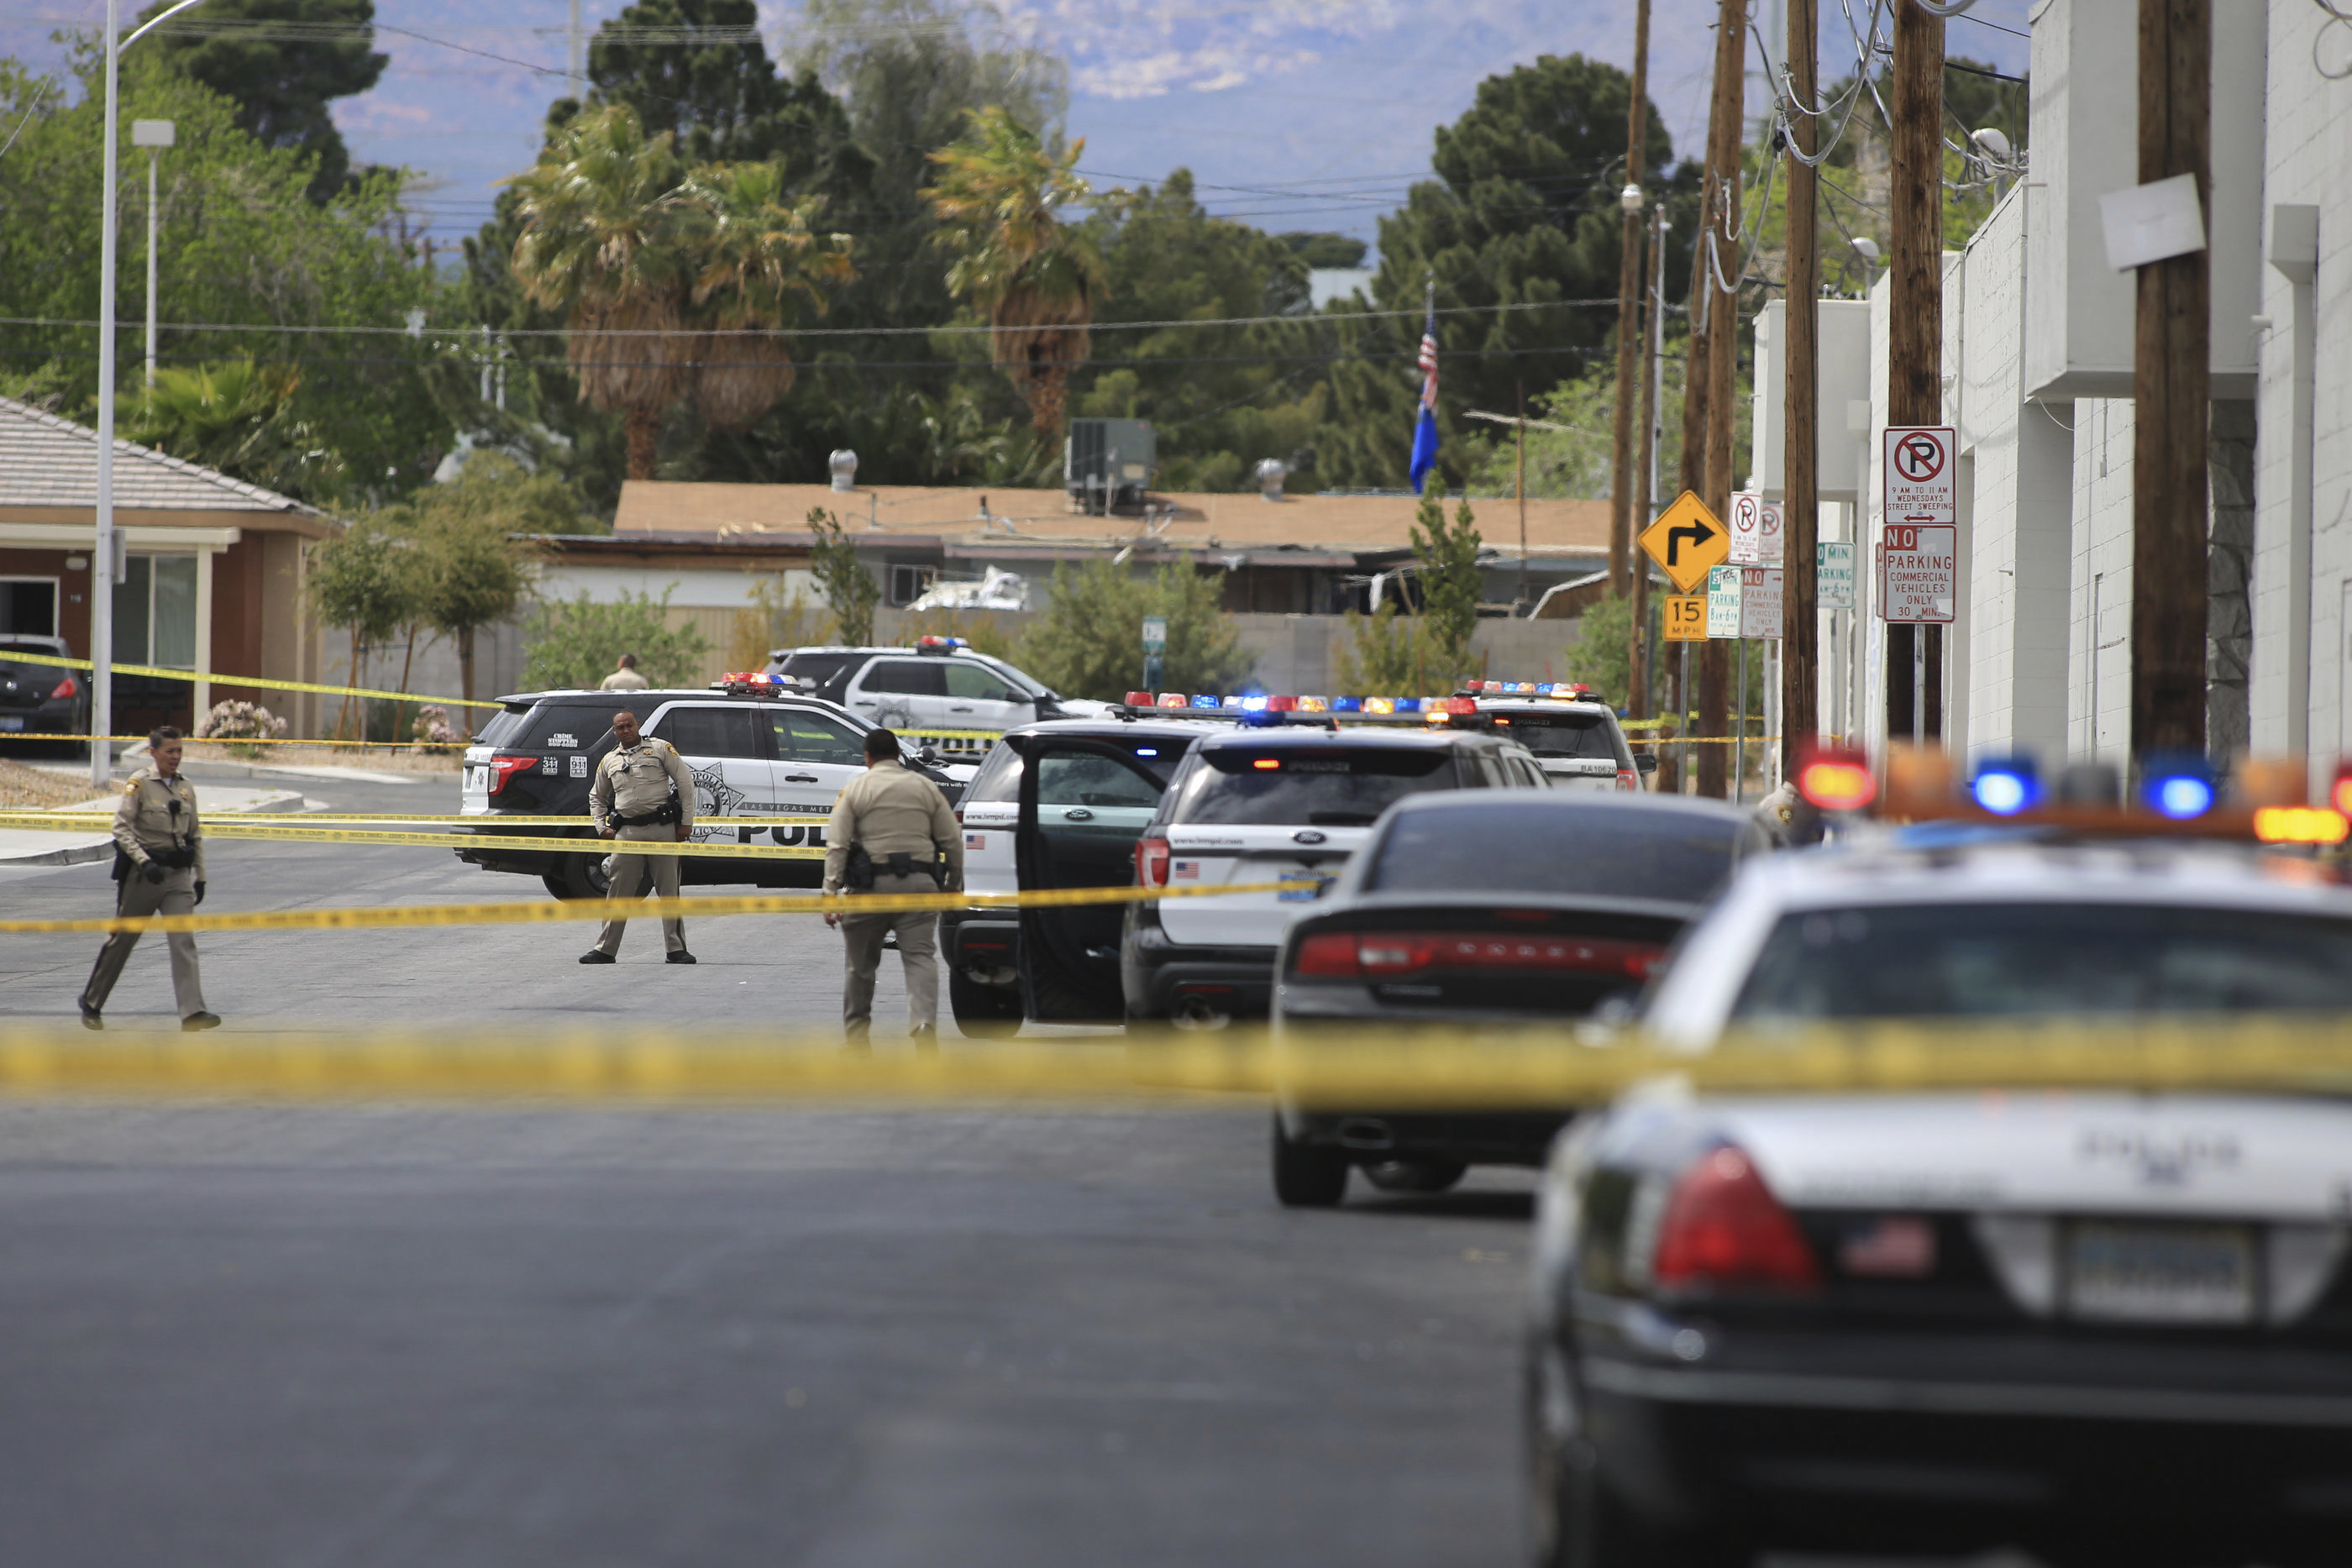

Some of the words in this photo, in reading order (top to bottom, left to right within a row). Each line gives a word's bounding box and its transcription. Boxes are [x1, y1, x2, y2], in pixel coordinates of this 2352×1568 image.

[1887, 528, 1914, 547] NO
[1888, 555, 1952, 569] PARKING
[1744, 570, 1762, 584] NO
[1890, 573, 1949, 581] COMMERCIAL
[1895, 584, 1945, 593] VEHICLES
[1710, 593, 1740, 606] PARKING
[1907, 595, 1933, 605] ONLY
[1673, 602, 1699, 621] 15
[1898, 607, 1911, 616] 30
[769, 804, 803, 812] VEGAS
